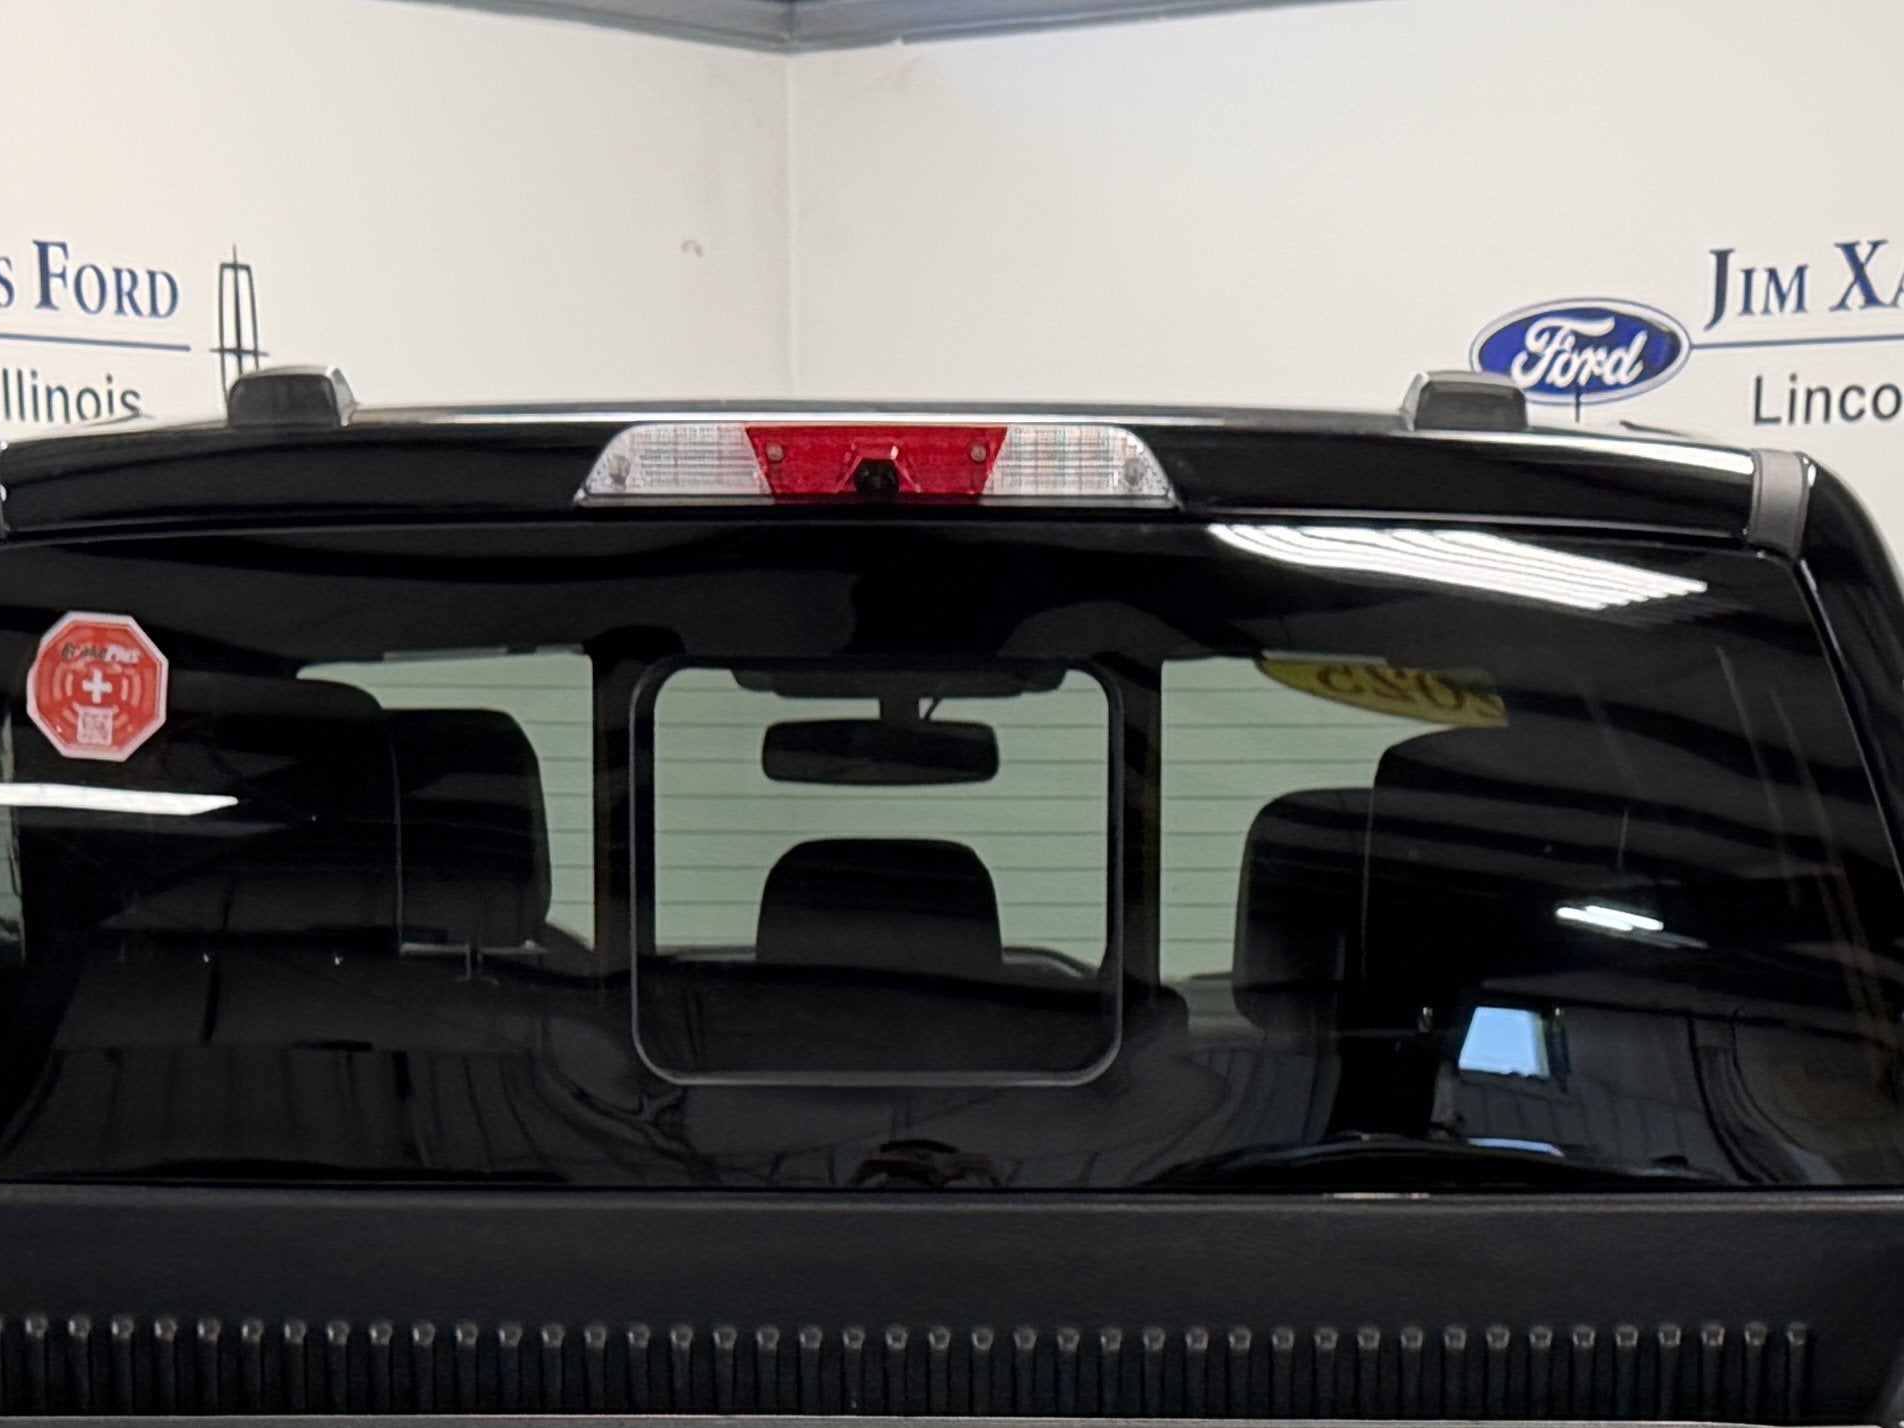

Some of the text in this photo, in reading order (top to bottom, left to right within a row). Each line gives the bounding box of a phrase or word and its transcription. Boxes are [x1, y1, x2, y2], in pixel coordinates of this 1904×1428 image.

[34, 240, 180, 322] FORD
[1704, 247, 1809, 332] JIM
[1510, 315, 1645, 388] Ford
